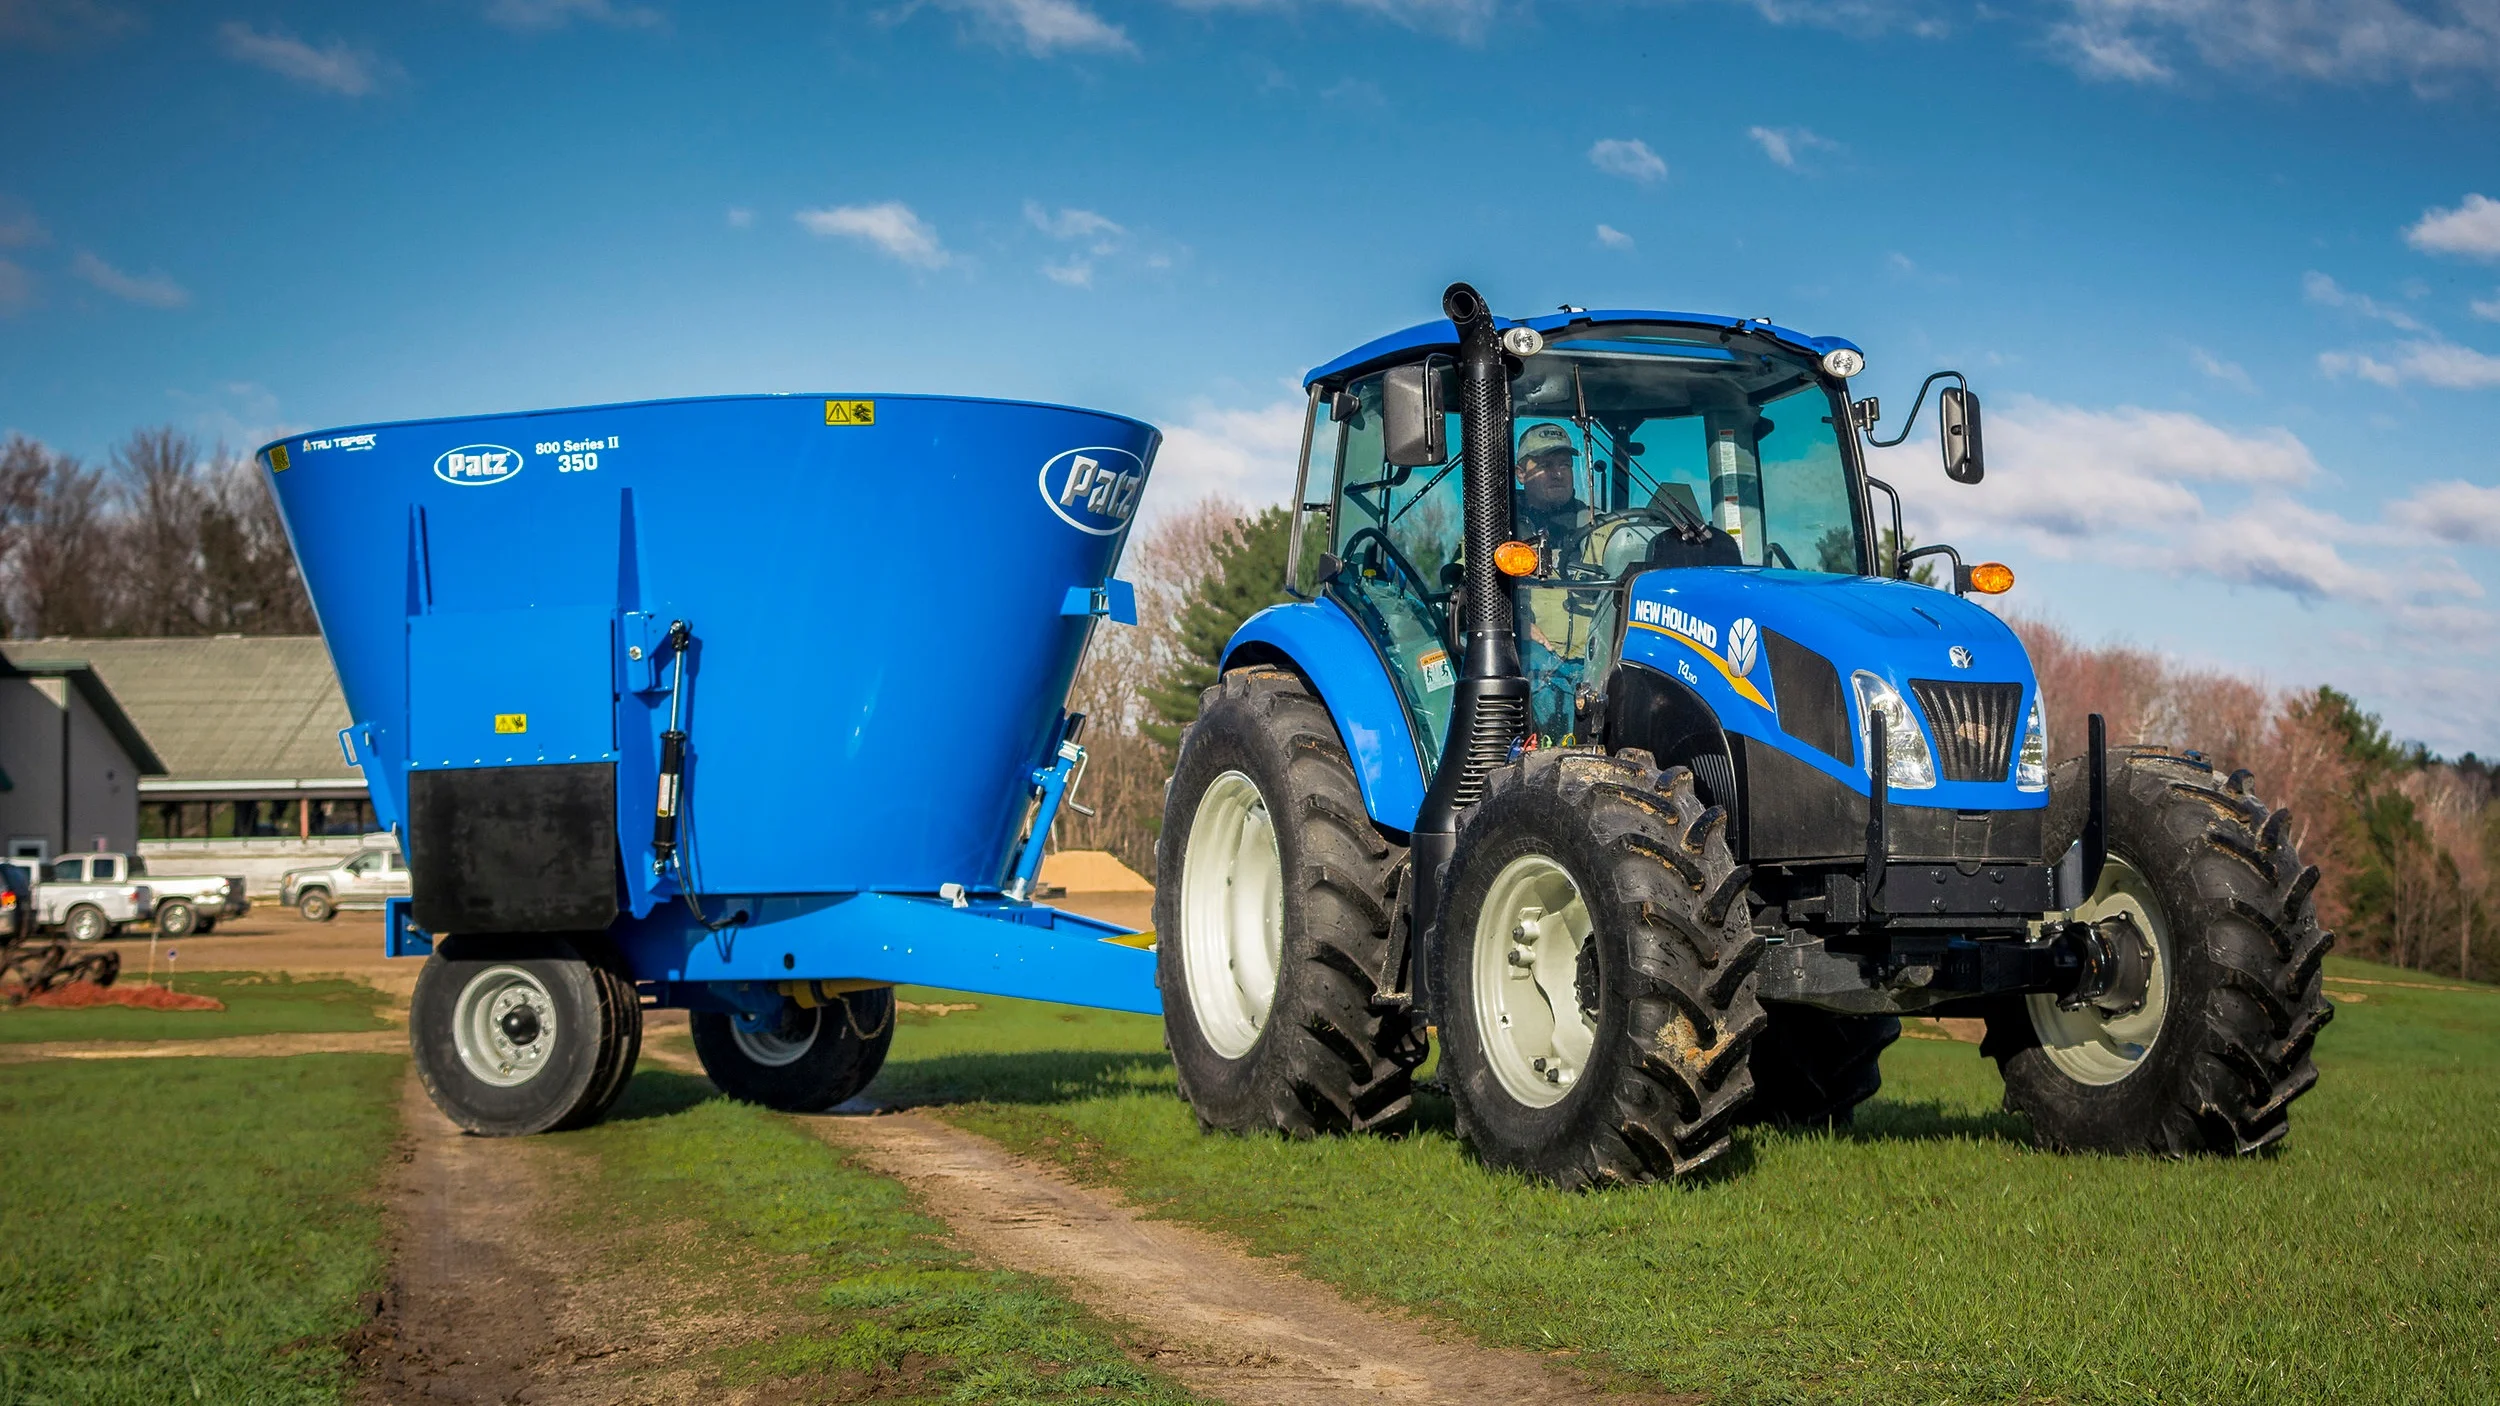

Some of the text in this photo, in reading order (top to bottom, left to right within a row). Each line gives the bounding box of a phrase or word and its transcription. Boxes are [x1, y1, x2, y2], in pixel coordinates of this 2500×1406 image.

[535, 436, 620, 455] 800 Series II
[448, 451, 509, 478] Patz
[558, 452, 598, 473] 350
[1060, 454, 1140, 521] Patz
[1635, 599, 1718, 649] NEW HOLLAND
